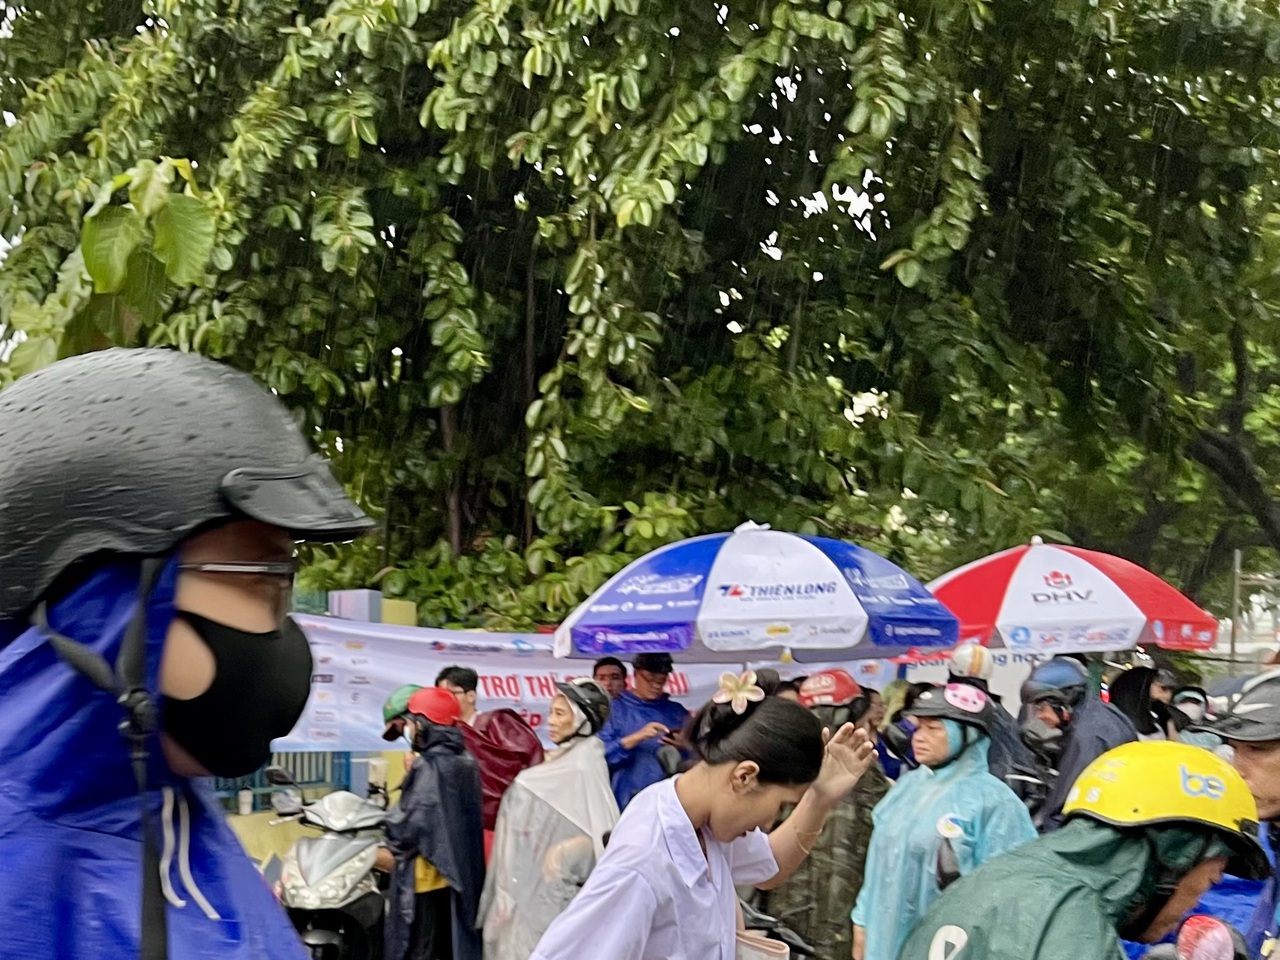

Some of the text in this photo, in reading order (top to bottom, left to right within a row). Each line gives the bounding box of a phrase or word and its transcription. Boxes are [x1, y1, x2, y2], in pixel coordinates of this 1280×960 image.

[1032, 590, 1094, 605] DHV
[479, 674, 521, 703] TRỢ
[1180, 764, 1226, 800] be
